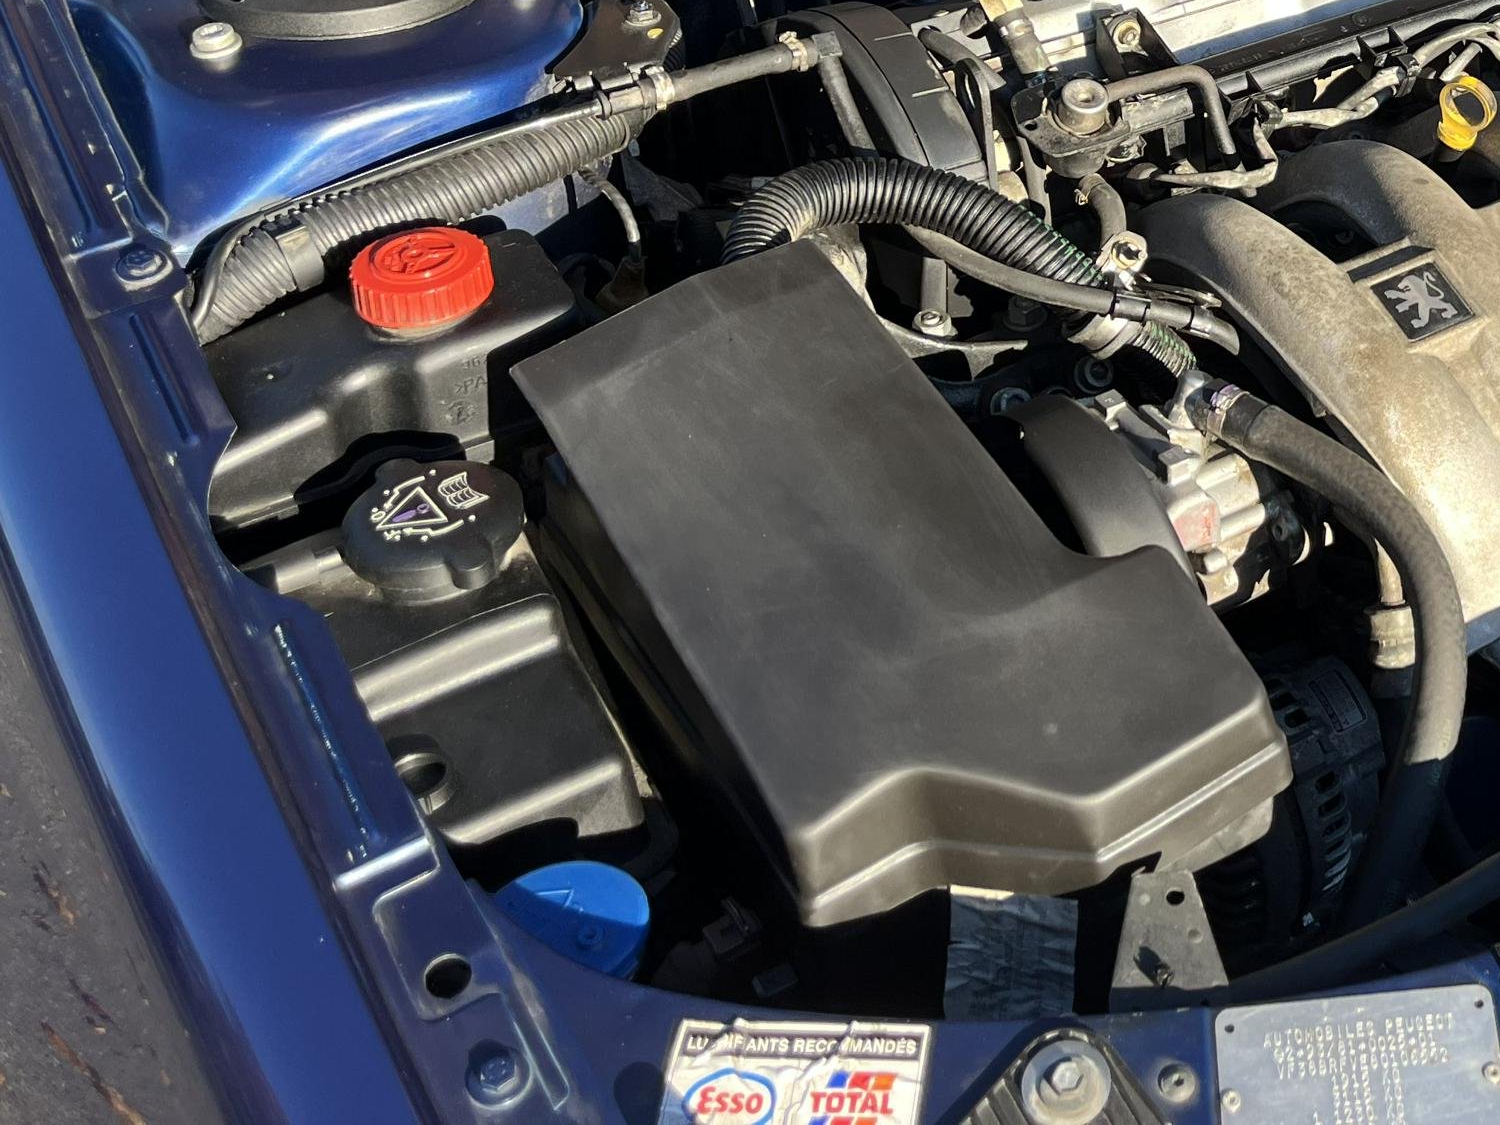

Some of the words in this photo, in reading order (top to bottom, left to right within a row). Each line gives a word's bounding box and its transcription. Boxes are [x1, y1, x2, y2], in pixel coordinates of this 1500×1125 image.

[1264, 1021, 1375, 1048] AUTOMOBILES
[1385, 1012, 1454, 1034] PEUGEOT
[810, 1091, 893, 1115] TOTAL
